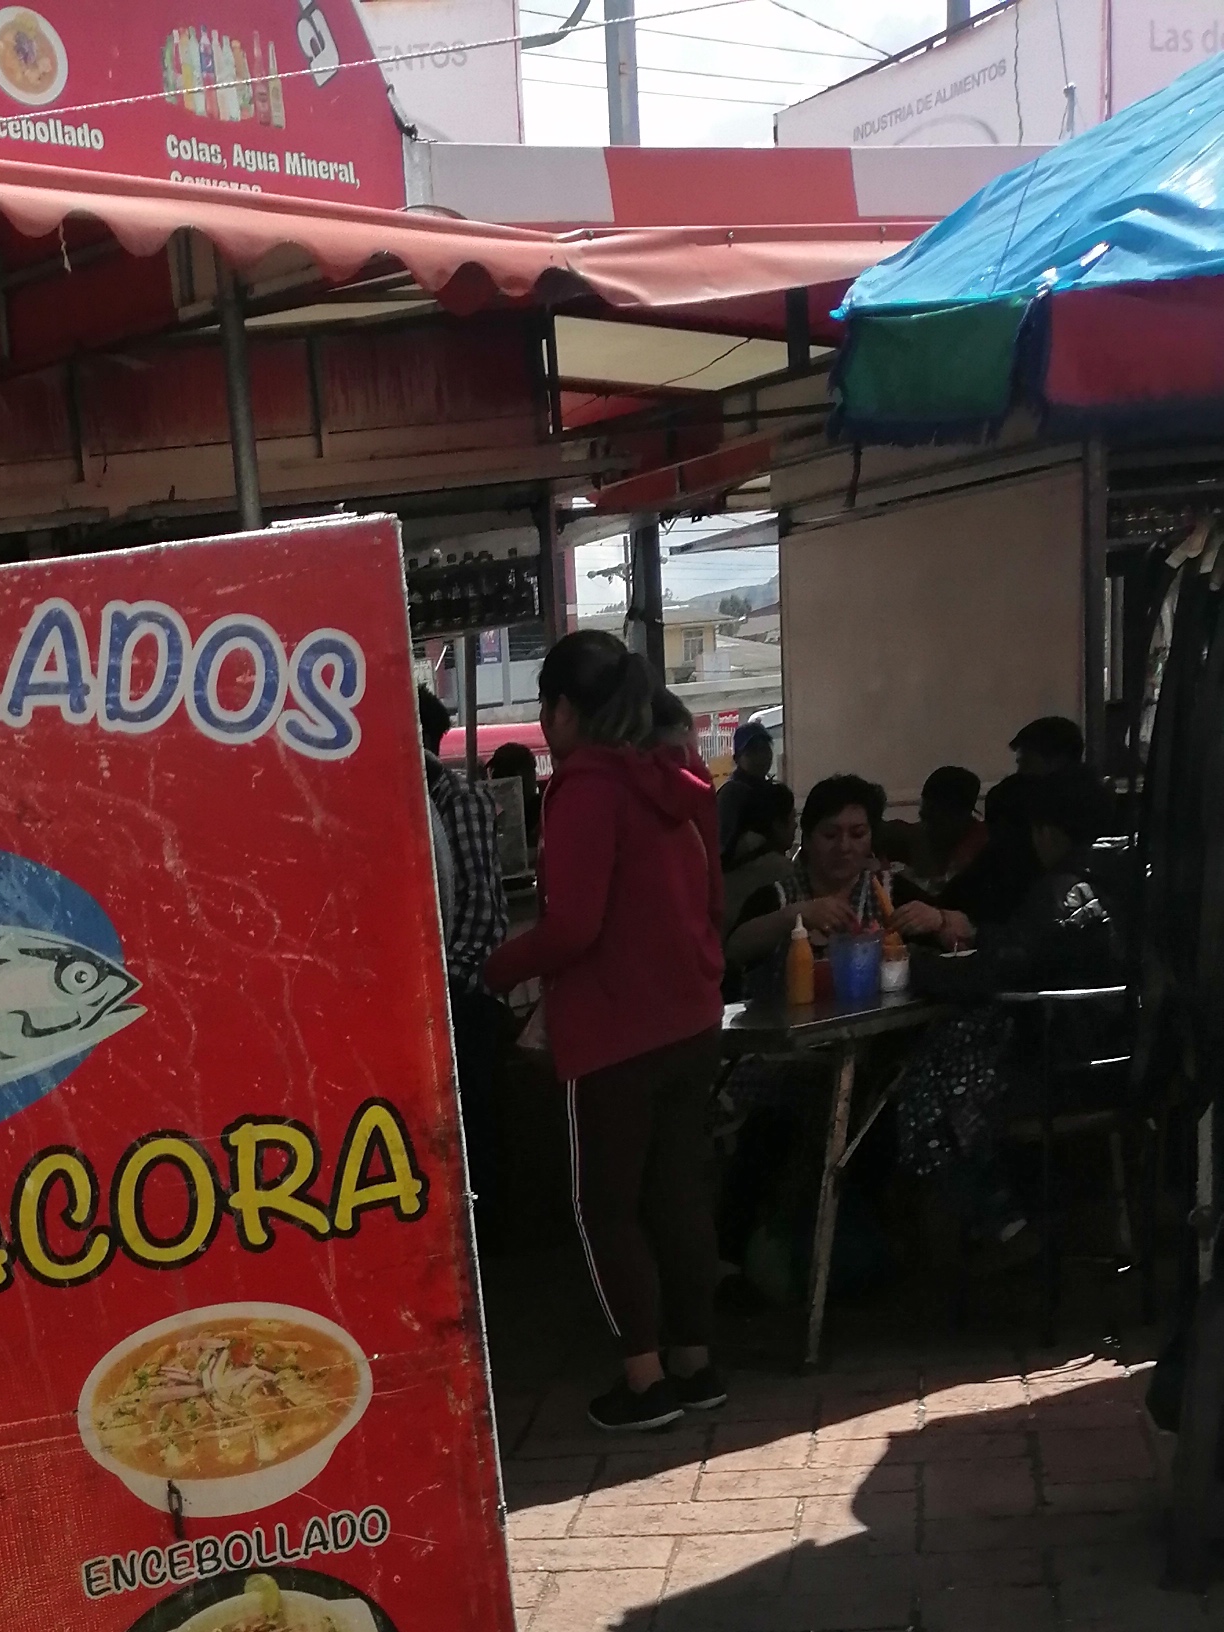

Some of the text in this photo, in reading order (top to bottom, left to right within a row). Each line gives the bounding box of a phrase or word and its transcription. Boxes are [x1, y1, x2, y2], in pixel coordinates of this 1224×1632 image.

[1150, 18, 1224, 54] Las d
[852, 58, 1007, 142] INDUSTRIA DE ALIMENTOS
[166, 134, 228, 170] Colas,
[232, 143, 281, 173] Agua
[284, 151, 361, 190] Mineral,
[83, 1508, 390, 1599] ENCEBOLLADO
